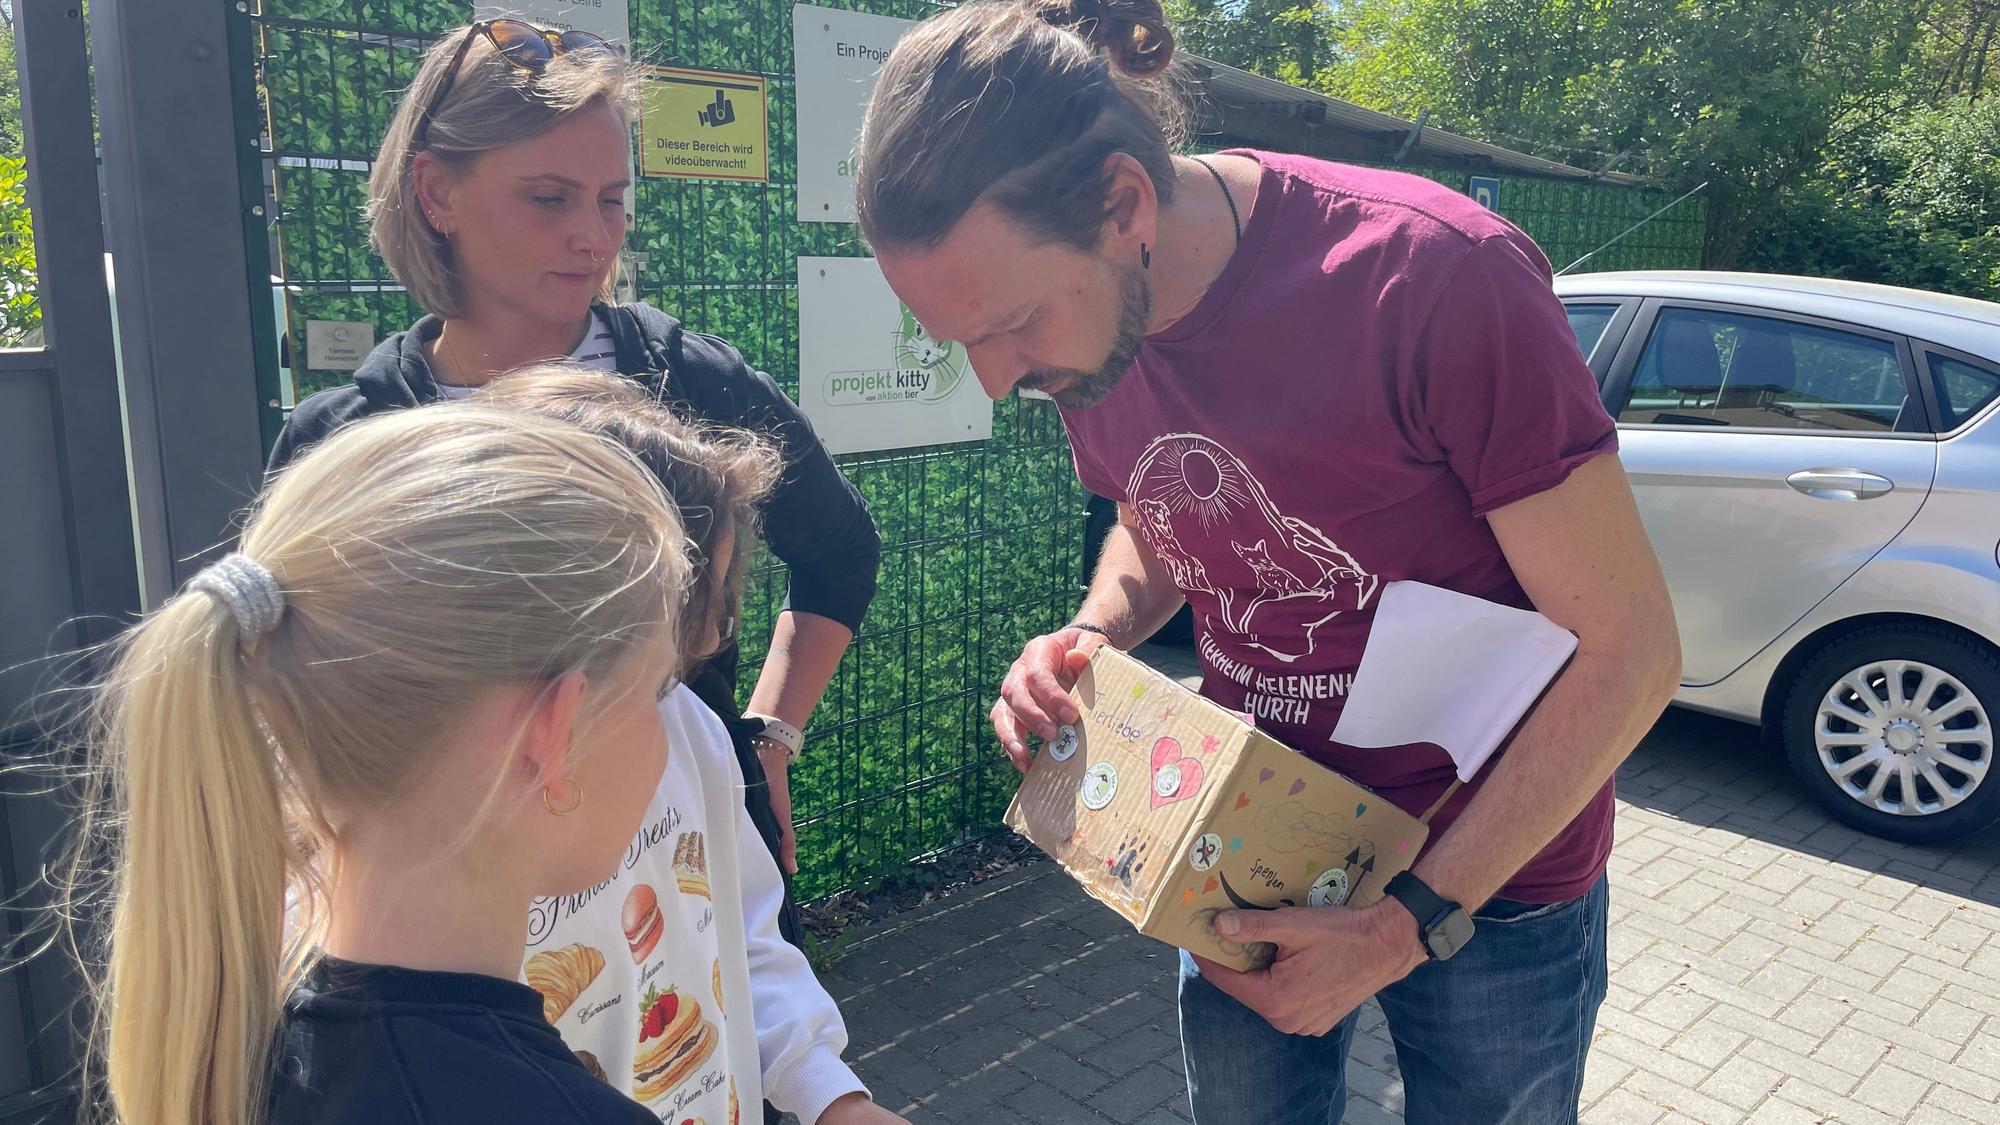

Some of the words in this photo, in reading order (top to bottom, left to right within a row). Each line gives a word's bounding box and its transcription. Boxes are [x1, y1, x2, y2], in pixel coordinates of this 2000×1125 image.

[836, 42, 856, 58] Ein
[657, 138, 690, 150] Dieser
[692, 140, 731, 153] Bereich
[732, 144, 753, 155] wird
[665, 155, 747, 169] videoüberwacht!
[831, 371, 893, 396] projekt
[896, 370, 930, 391] kitty
[877, 391, 903, 401] aktion
[905, 390, 919, 399] tier
[1200, 631, 1255, 687] TIERHEIM
[1088, 691, 1141, 743] Tierliebe
[526, 869, 619, 946] Fren
[623, 806, 682, 870] Treats
[1250, 858, 1285, 891] Spenden
[700, 1070, 726, 1093] Cake
